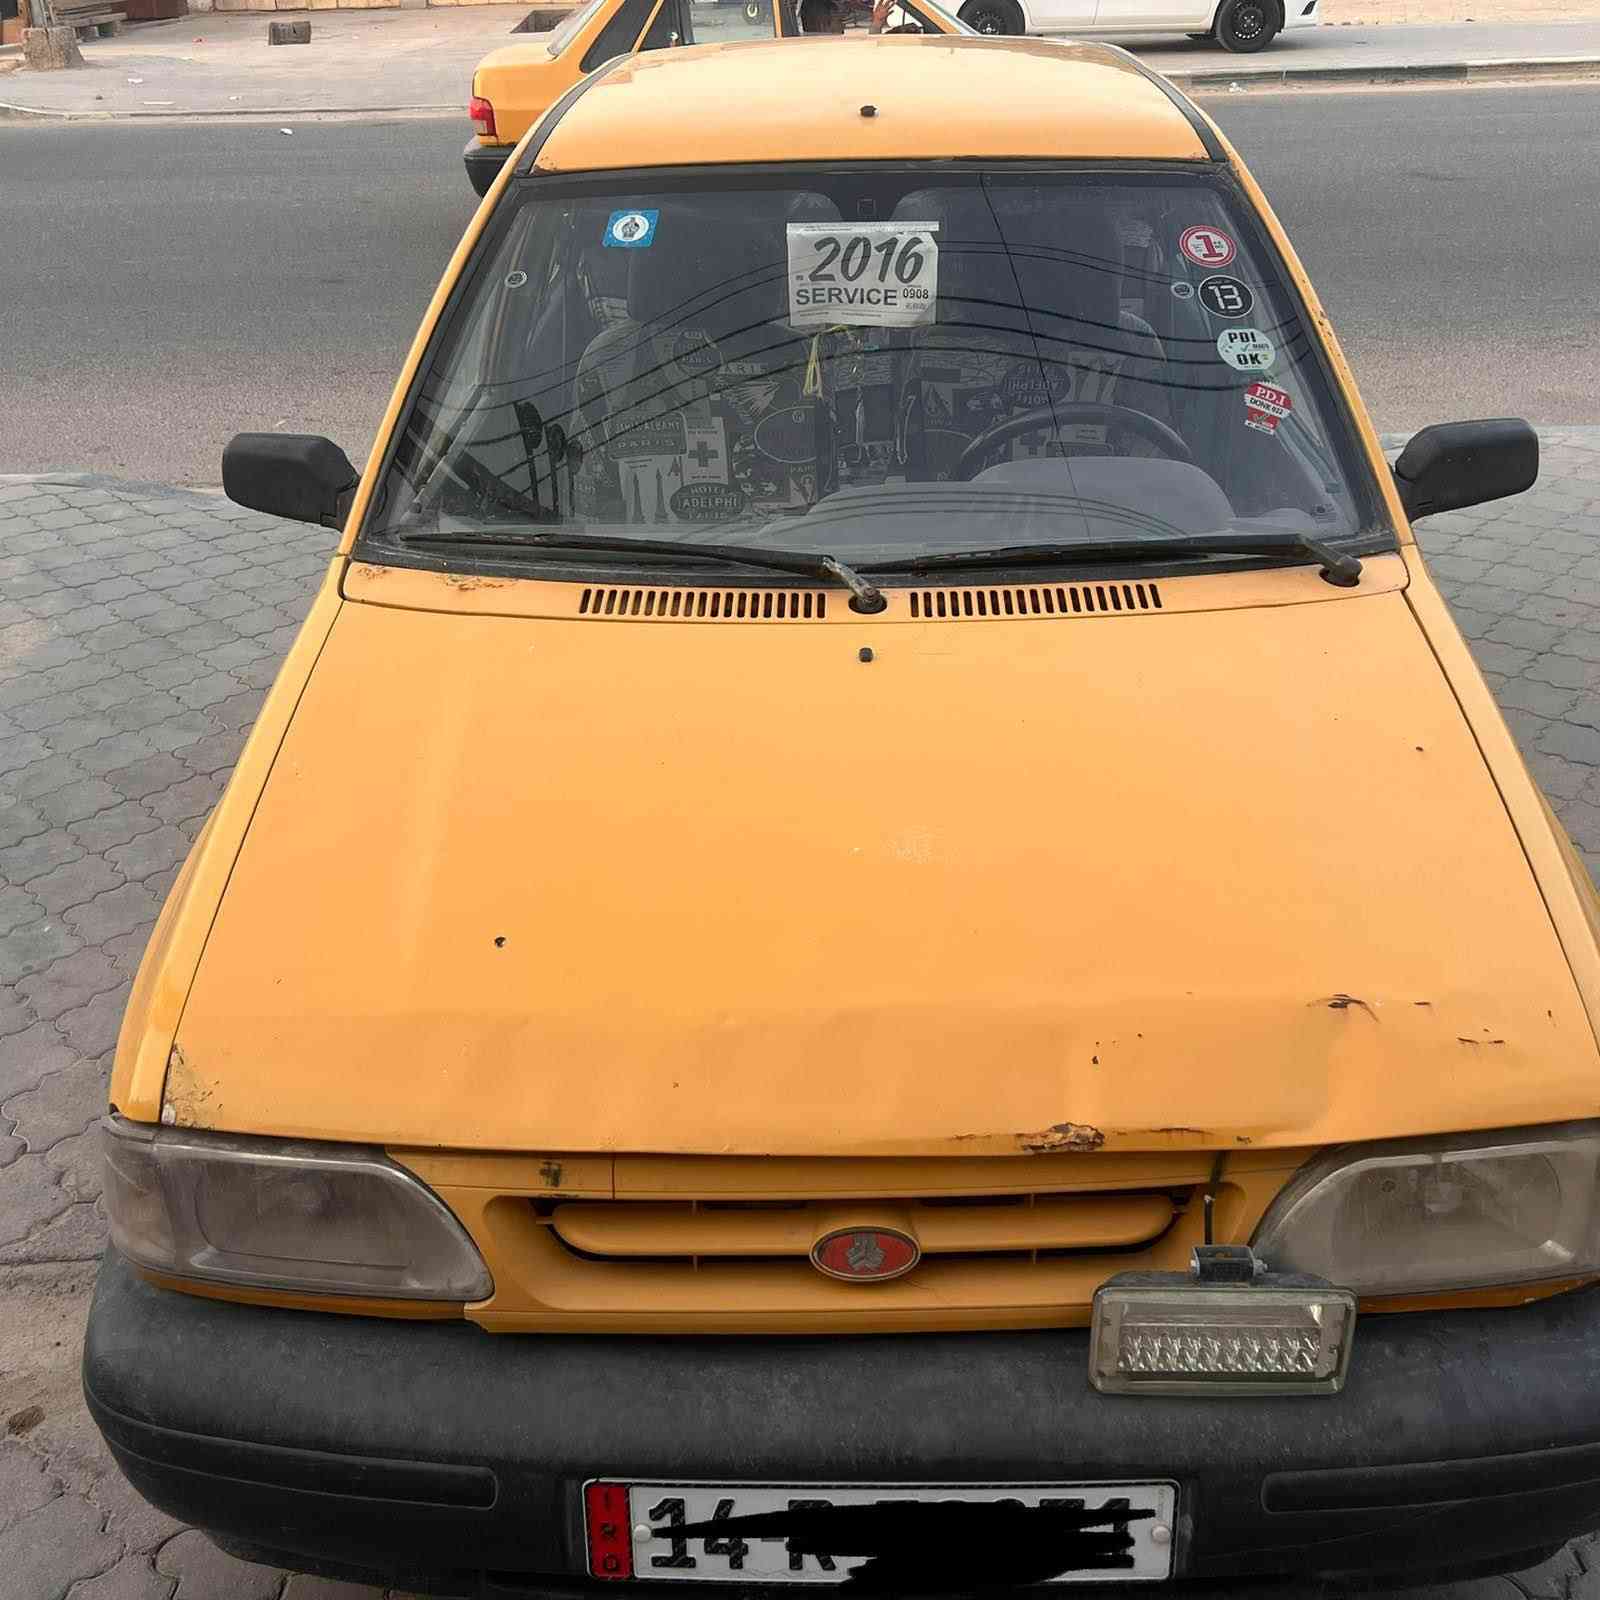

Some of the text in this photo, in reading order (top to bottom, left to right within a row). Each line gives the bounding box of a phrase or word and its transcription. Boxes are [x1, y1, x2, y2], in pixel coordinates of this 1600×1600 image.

[808, 236, 924, 284] 2016
[796, 287, 898, 306] SERVICE
[903, 287, 929, 300] 0908
[1208, 285, 1242, 309] 13
[1228, 331, 1257, 343] PDI
[1236, 353, 1262, 365] OK
[682, 497, 737, 509] ADELPHI
